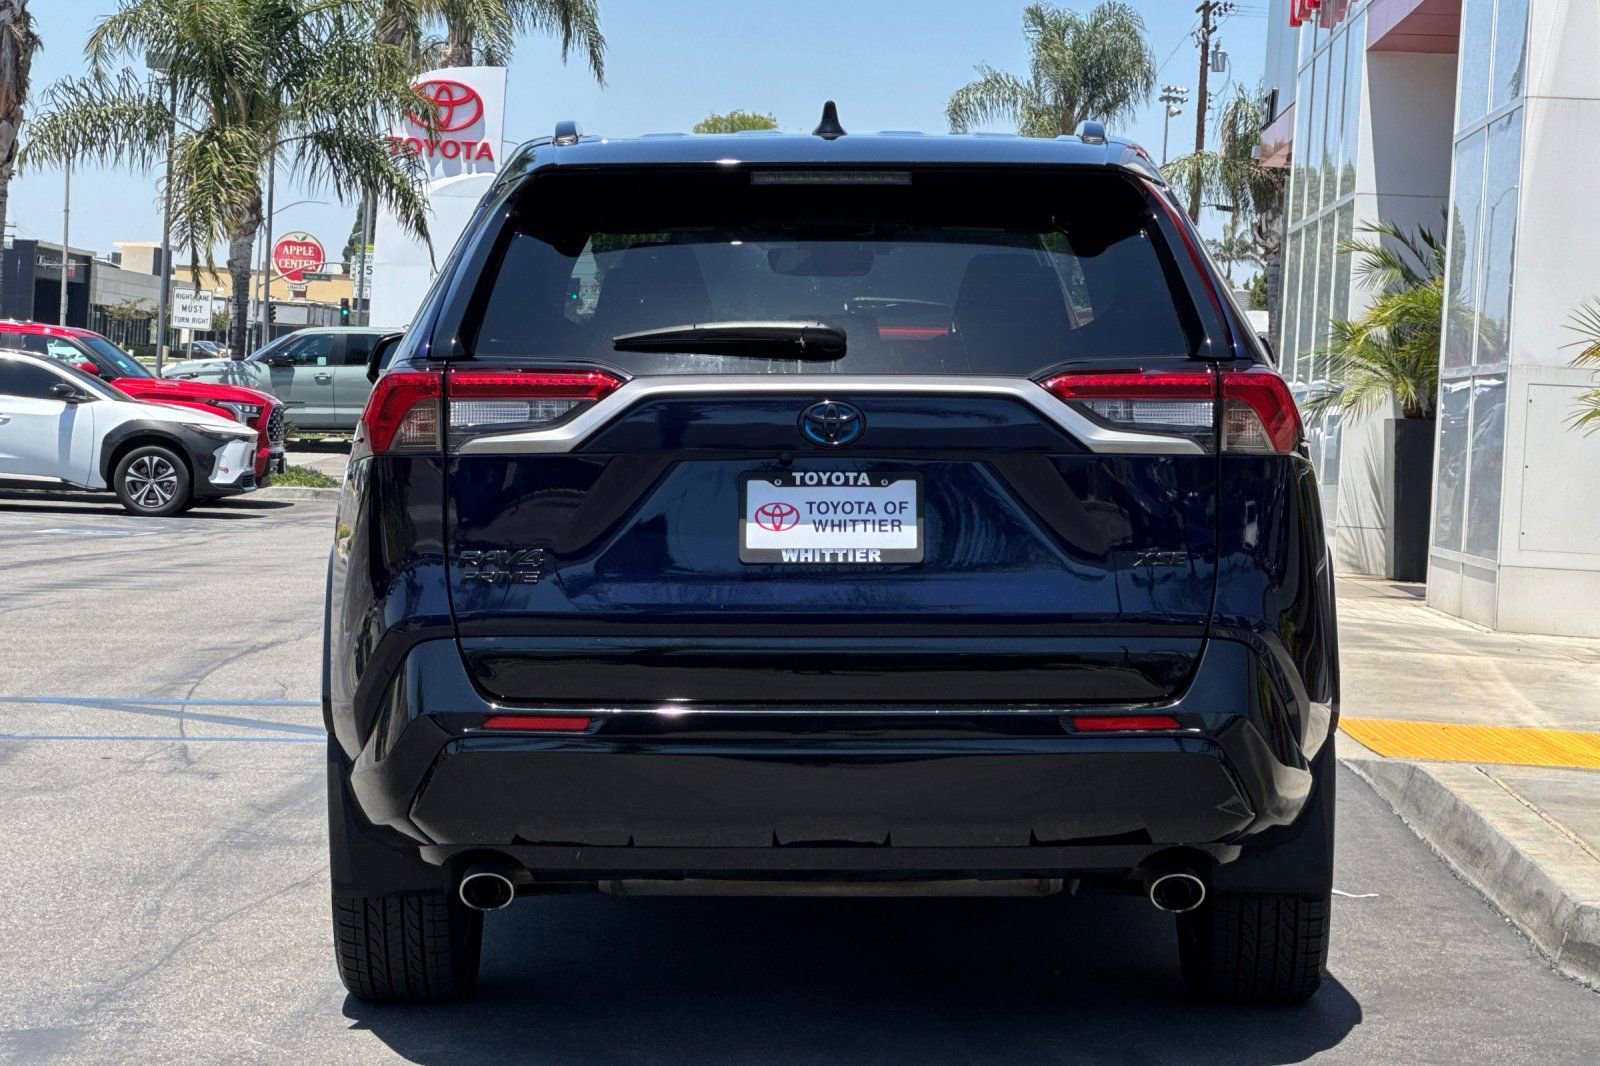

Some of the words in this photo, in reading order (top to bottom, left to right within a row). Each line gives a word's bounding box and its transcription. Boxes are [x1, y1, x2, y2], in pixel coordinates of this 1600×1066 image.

[387, 136, 494, 161] TOYOTA
[281, 245, 315, 257] APPLE
[278, 258, 317, 270] CENTER
[181, 304, 203, 313] MUST
[191, 317, 209, 325] RIGHT
[792, 472, 871, 486] TOYOTA
[805, 501, 877, 515] TOYOTA
[884, 501, 909, 515] OF
[812, 519, 902, 533] WHITTIER
[781, 549, 882, 563] WHITTIER
